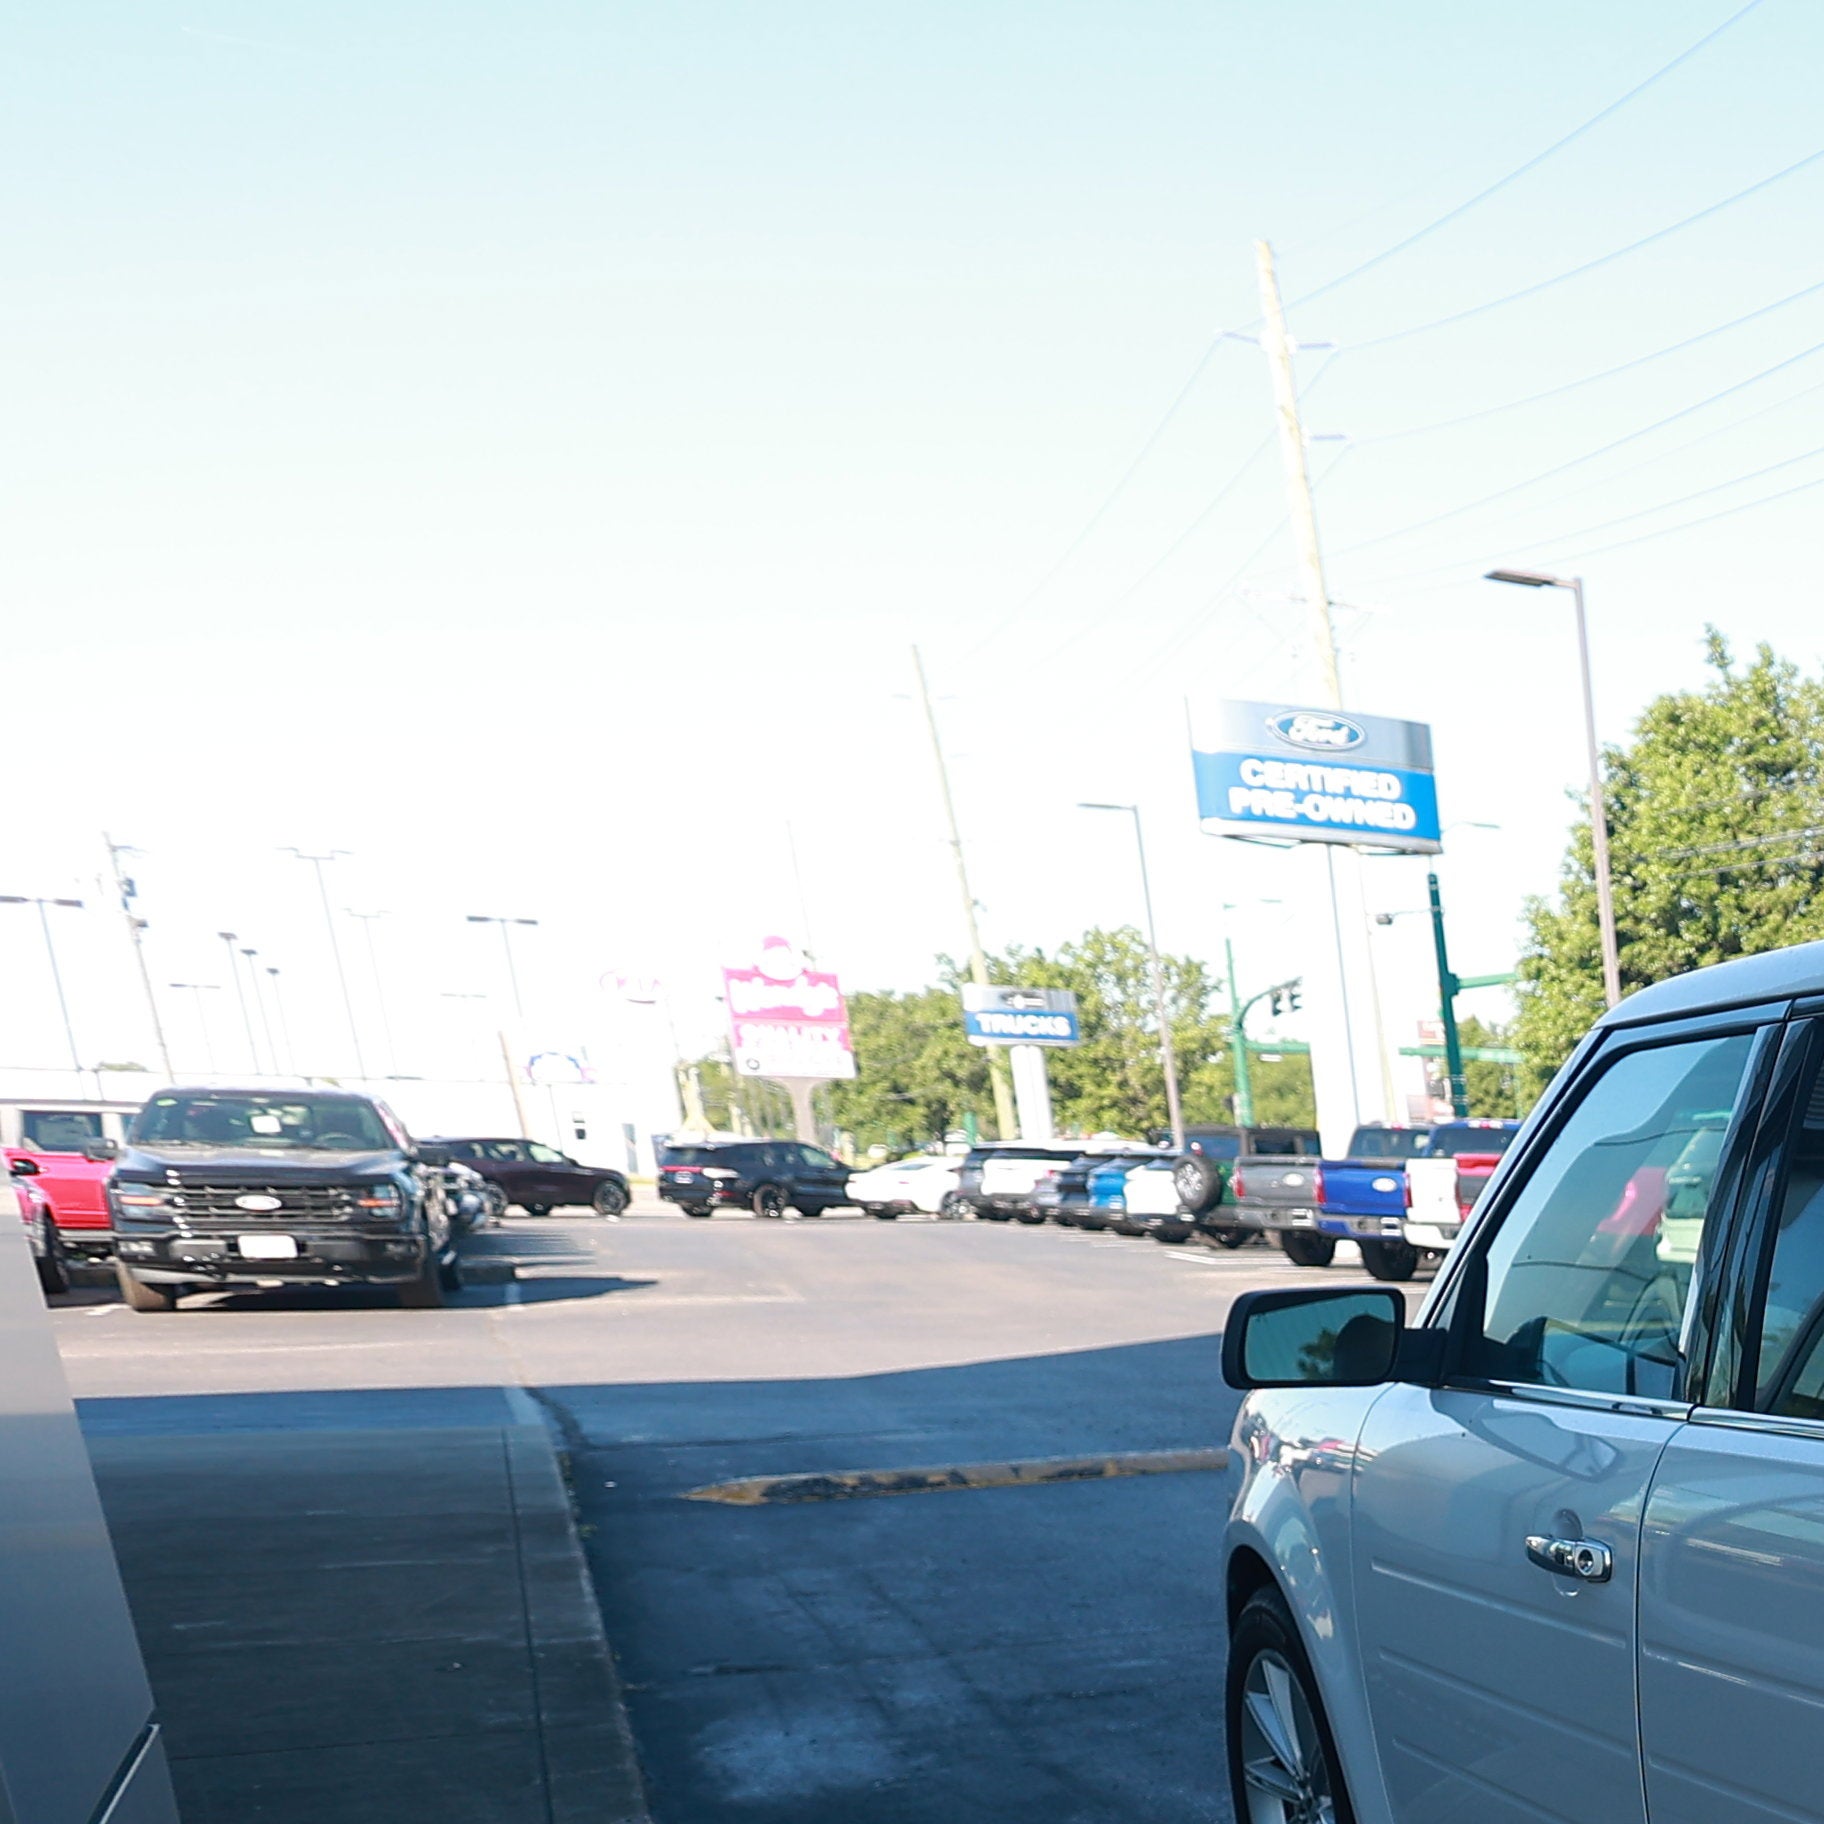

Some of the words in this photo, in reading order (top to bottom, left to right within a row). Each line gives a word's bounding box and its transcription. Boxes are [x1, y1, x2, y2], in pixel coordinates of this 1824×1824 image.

[1289, 715, 1349, 745] Ford
[1239, 758, 1401, 800] CERTIFIED
[1227, 787, 1417, 830] PRE-OWNED
[975, 1012, 1072, 1037] TRUCKS
